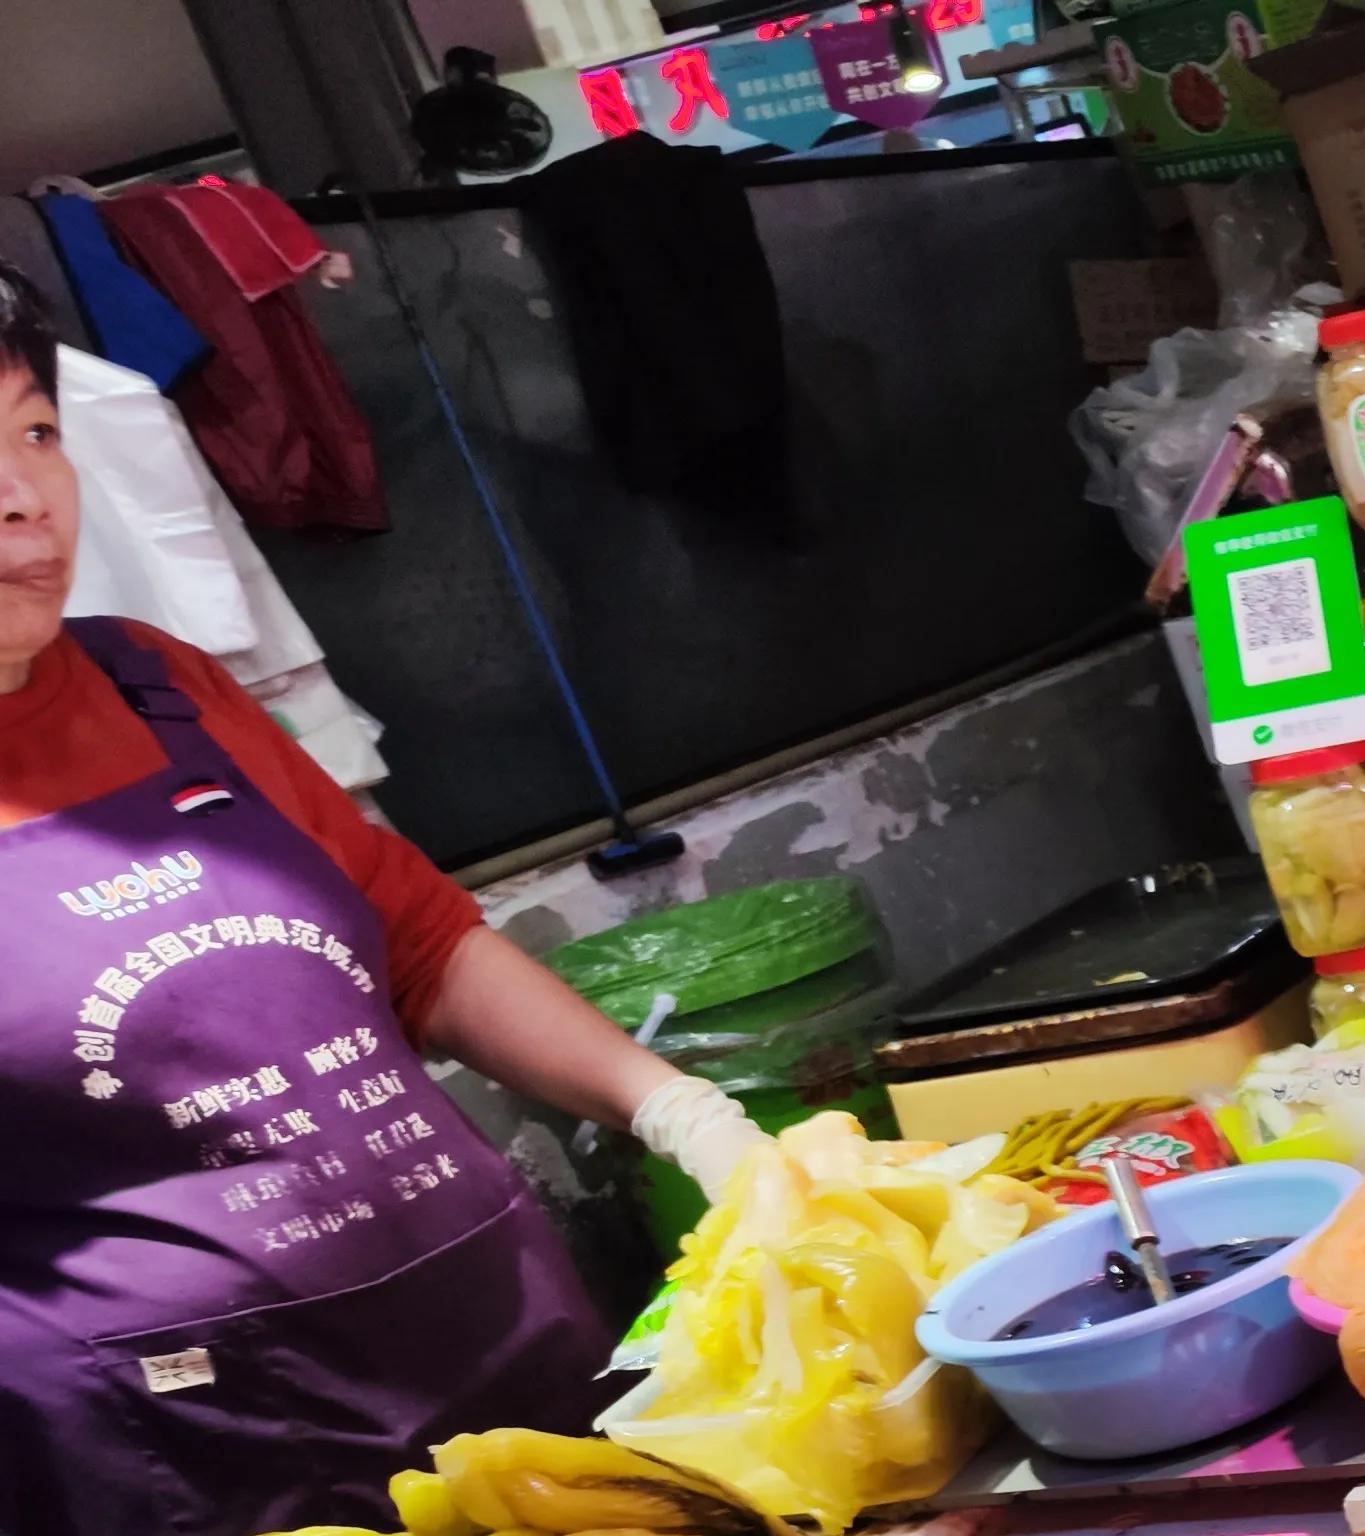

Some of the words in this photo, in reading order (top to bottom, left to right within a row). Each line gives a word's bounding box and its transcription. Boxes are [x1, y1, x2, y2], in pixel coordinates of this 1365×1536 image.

[164, 1065, 292, 1130] 新鲜实惠
[304, 1027, 378, 1076] 顾客多
